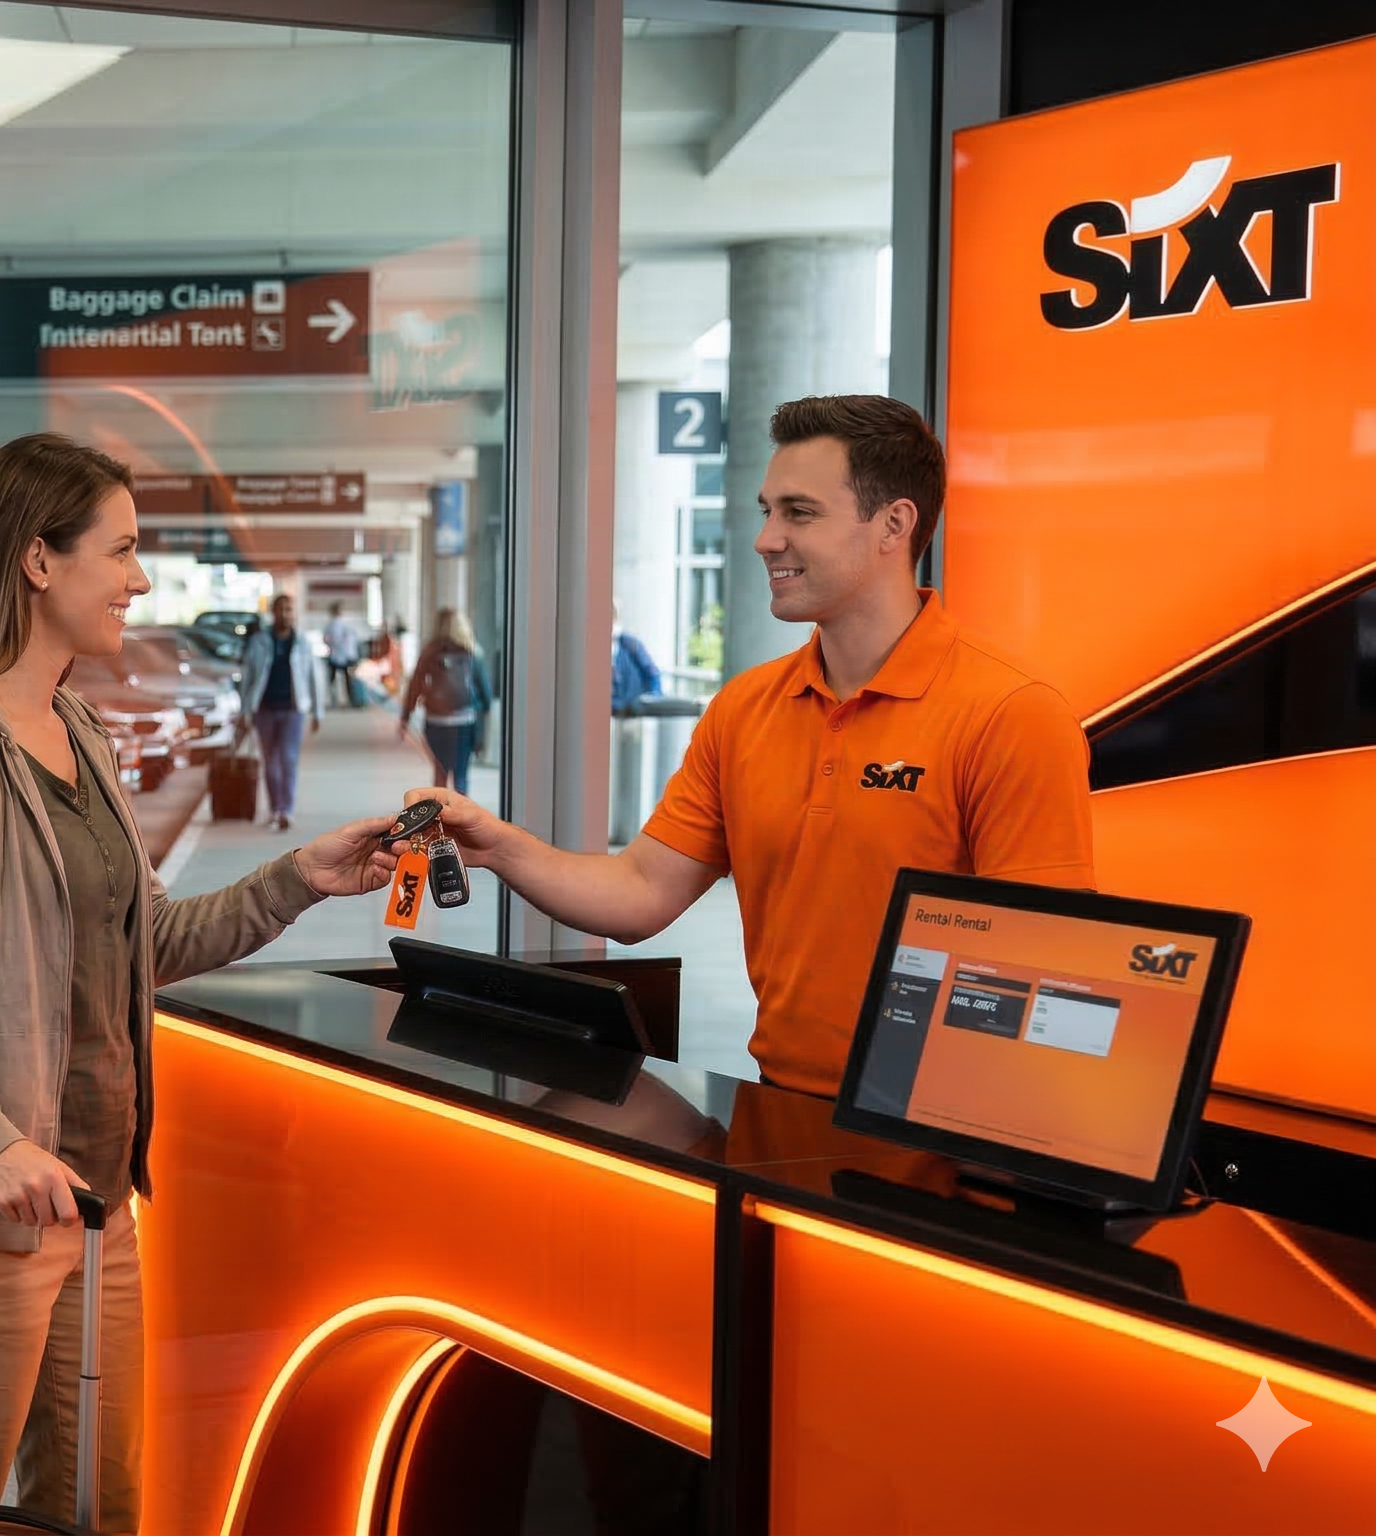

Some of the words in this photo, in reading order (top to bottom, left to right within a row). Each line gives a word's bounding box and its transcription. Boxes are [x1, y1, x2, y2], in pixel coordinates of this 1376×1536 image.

[1039, 155, 1342, 332] SIXT
[49, 285, 165, 317] Baggage
[170, 283, 246, 310] Claim
[672, 397, 705, 448] 2
[859, 760, 926, 793] SIXT
[395, 870, 420, 918] SIXT
[914, 908, 953, 927] Rental
[953, 914, 992, 932] Rental
[1128, 942, 1199, 979] SIXT
